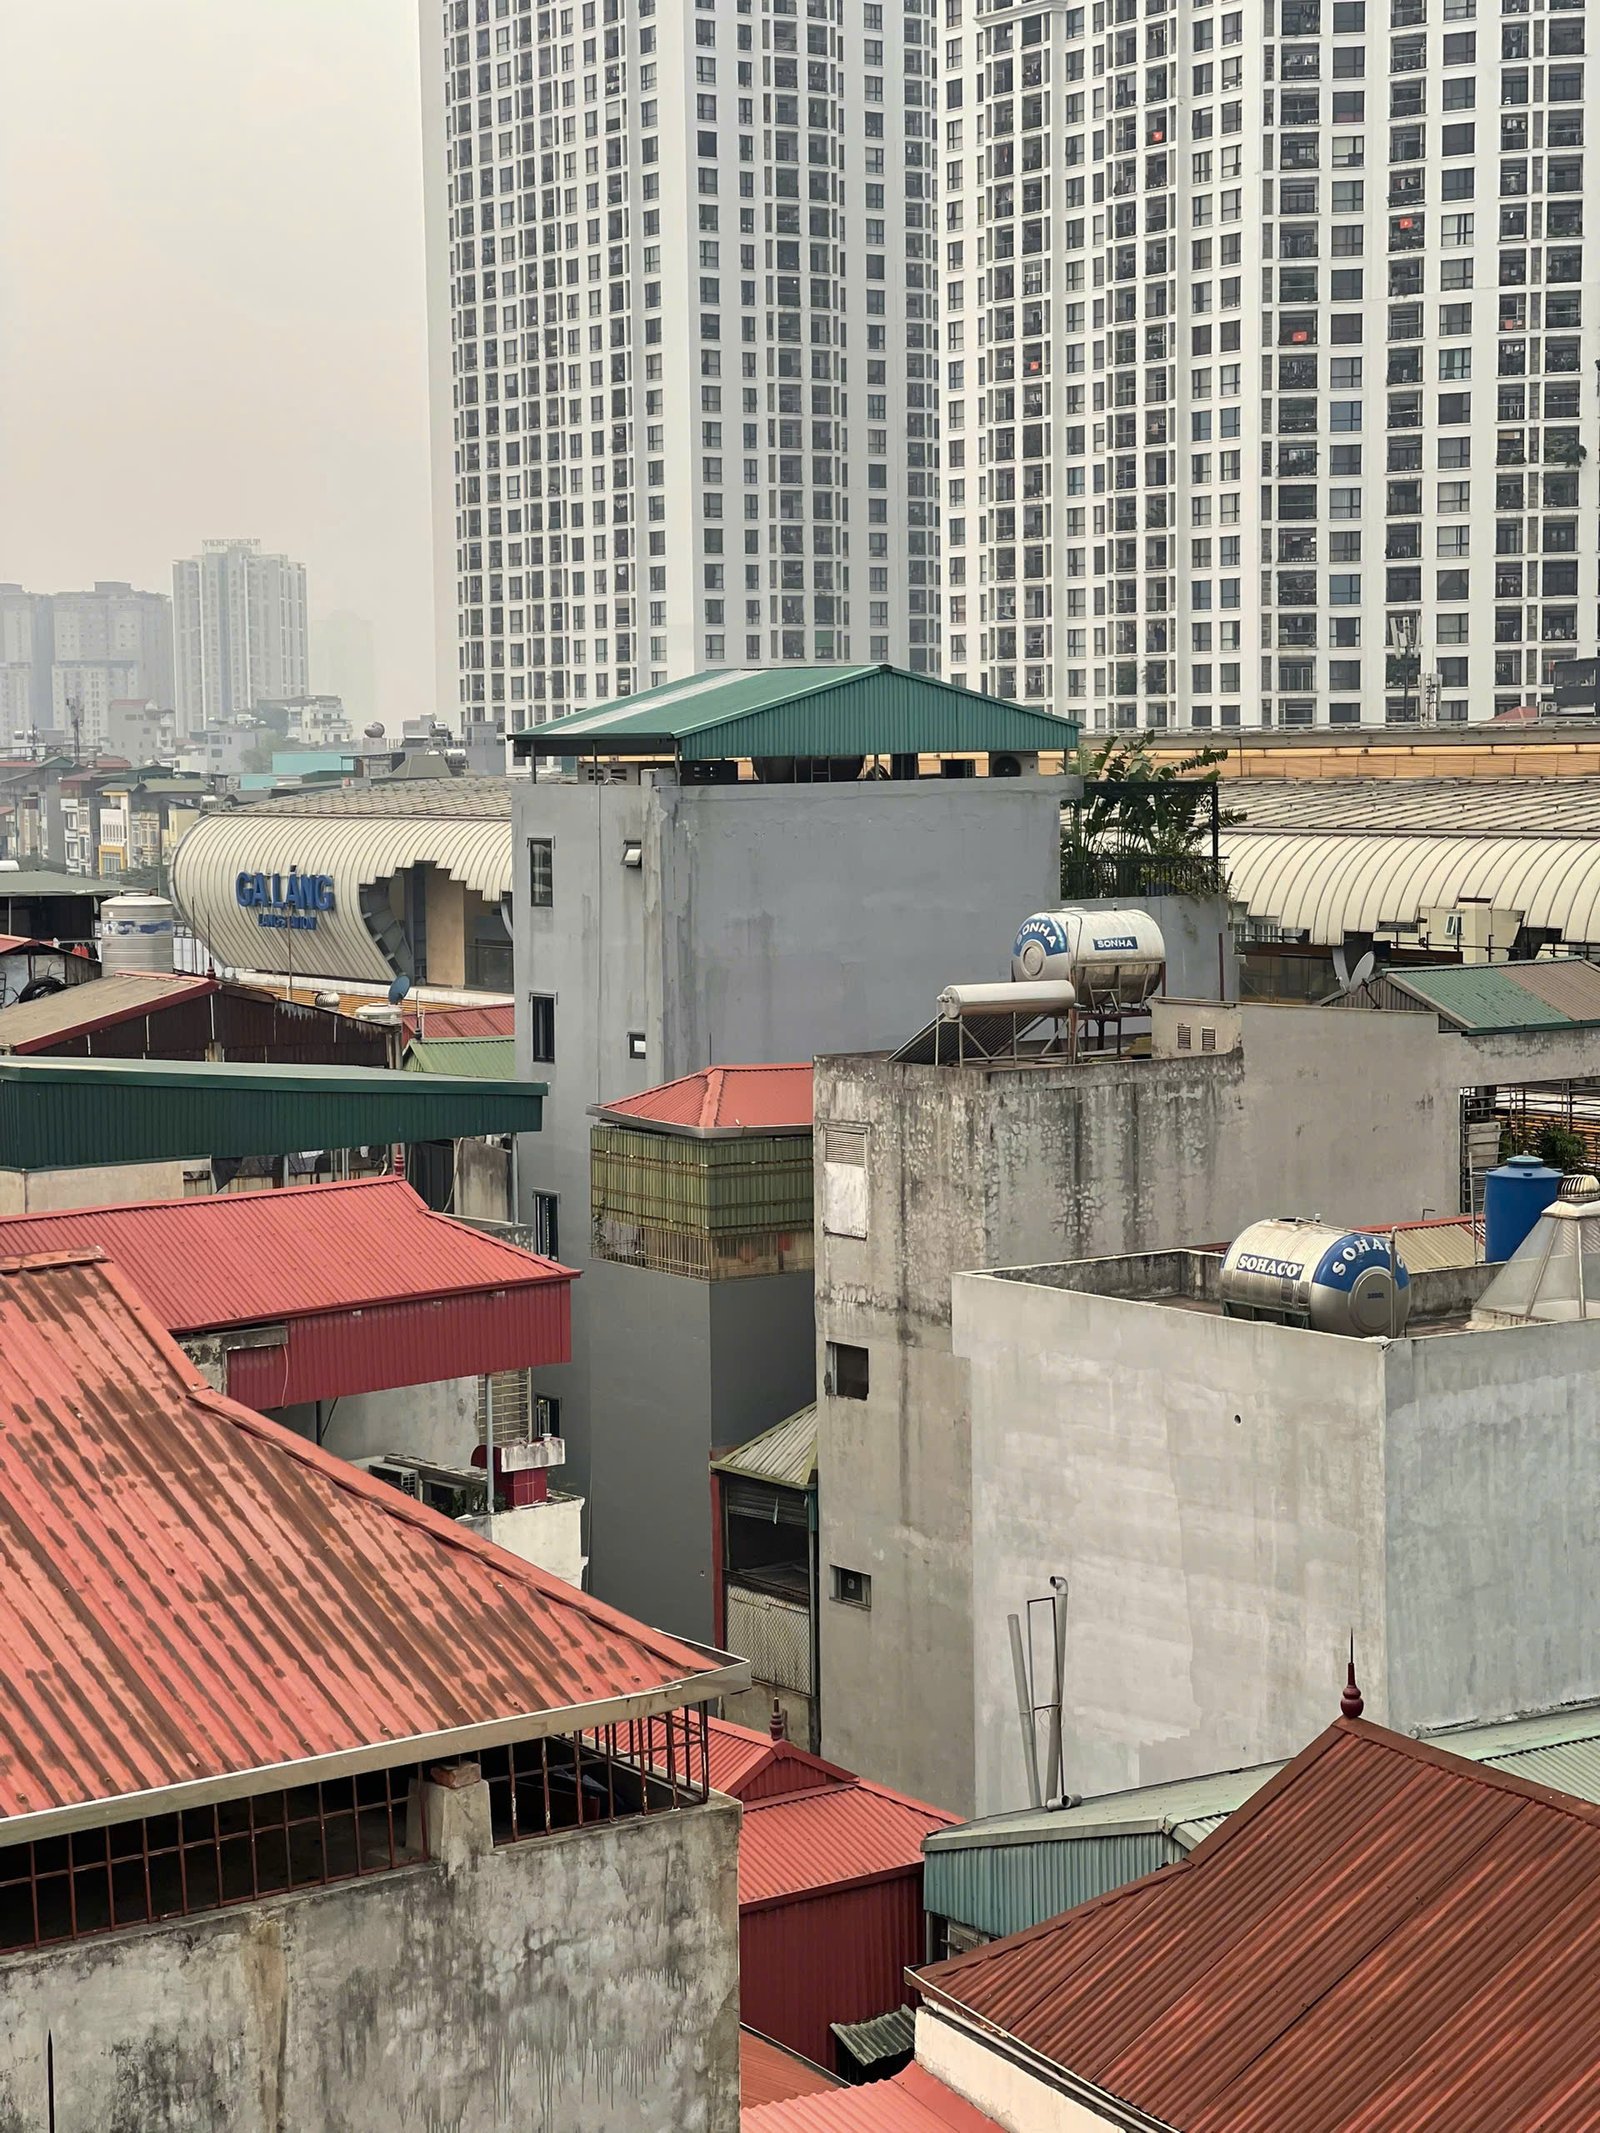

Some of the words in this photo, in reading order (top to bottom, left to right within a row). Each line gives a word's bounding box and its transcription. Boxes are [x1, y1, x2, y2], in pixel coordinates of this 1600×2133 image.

[236, 872, 268, 907] GA
[271, 865, 335, 911] LÁNG
[1016, 922, 1057, 948] SONHA
[1096, 938, 1134, 948] SONHA
[1237, 1254, 1300, 1278] SOHACO
